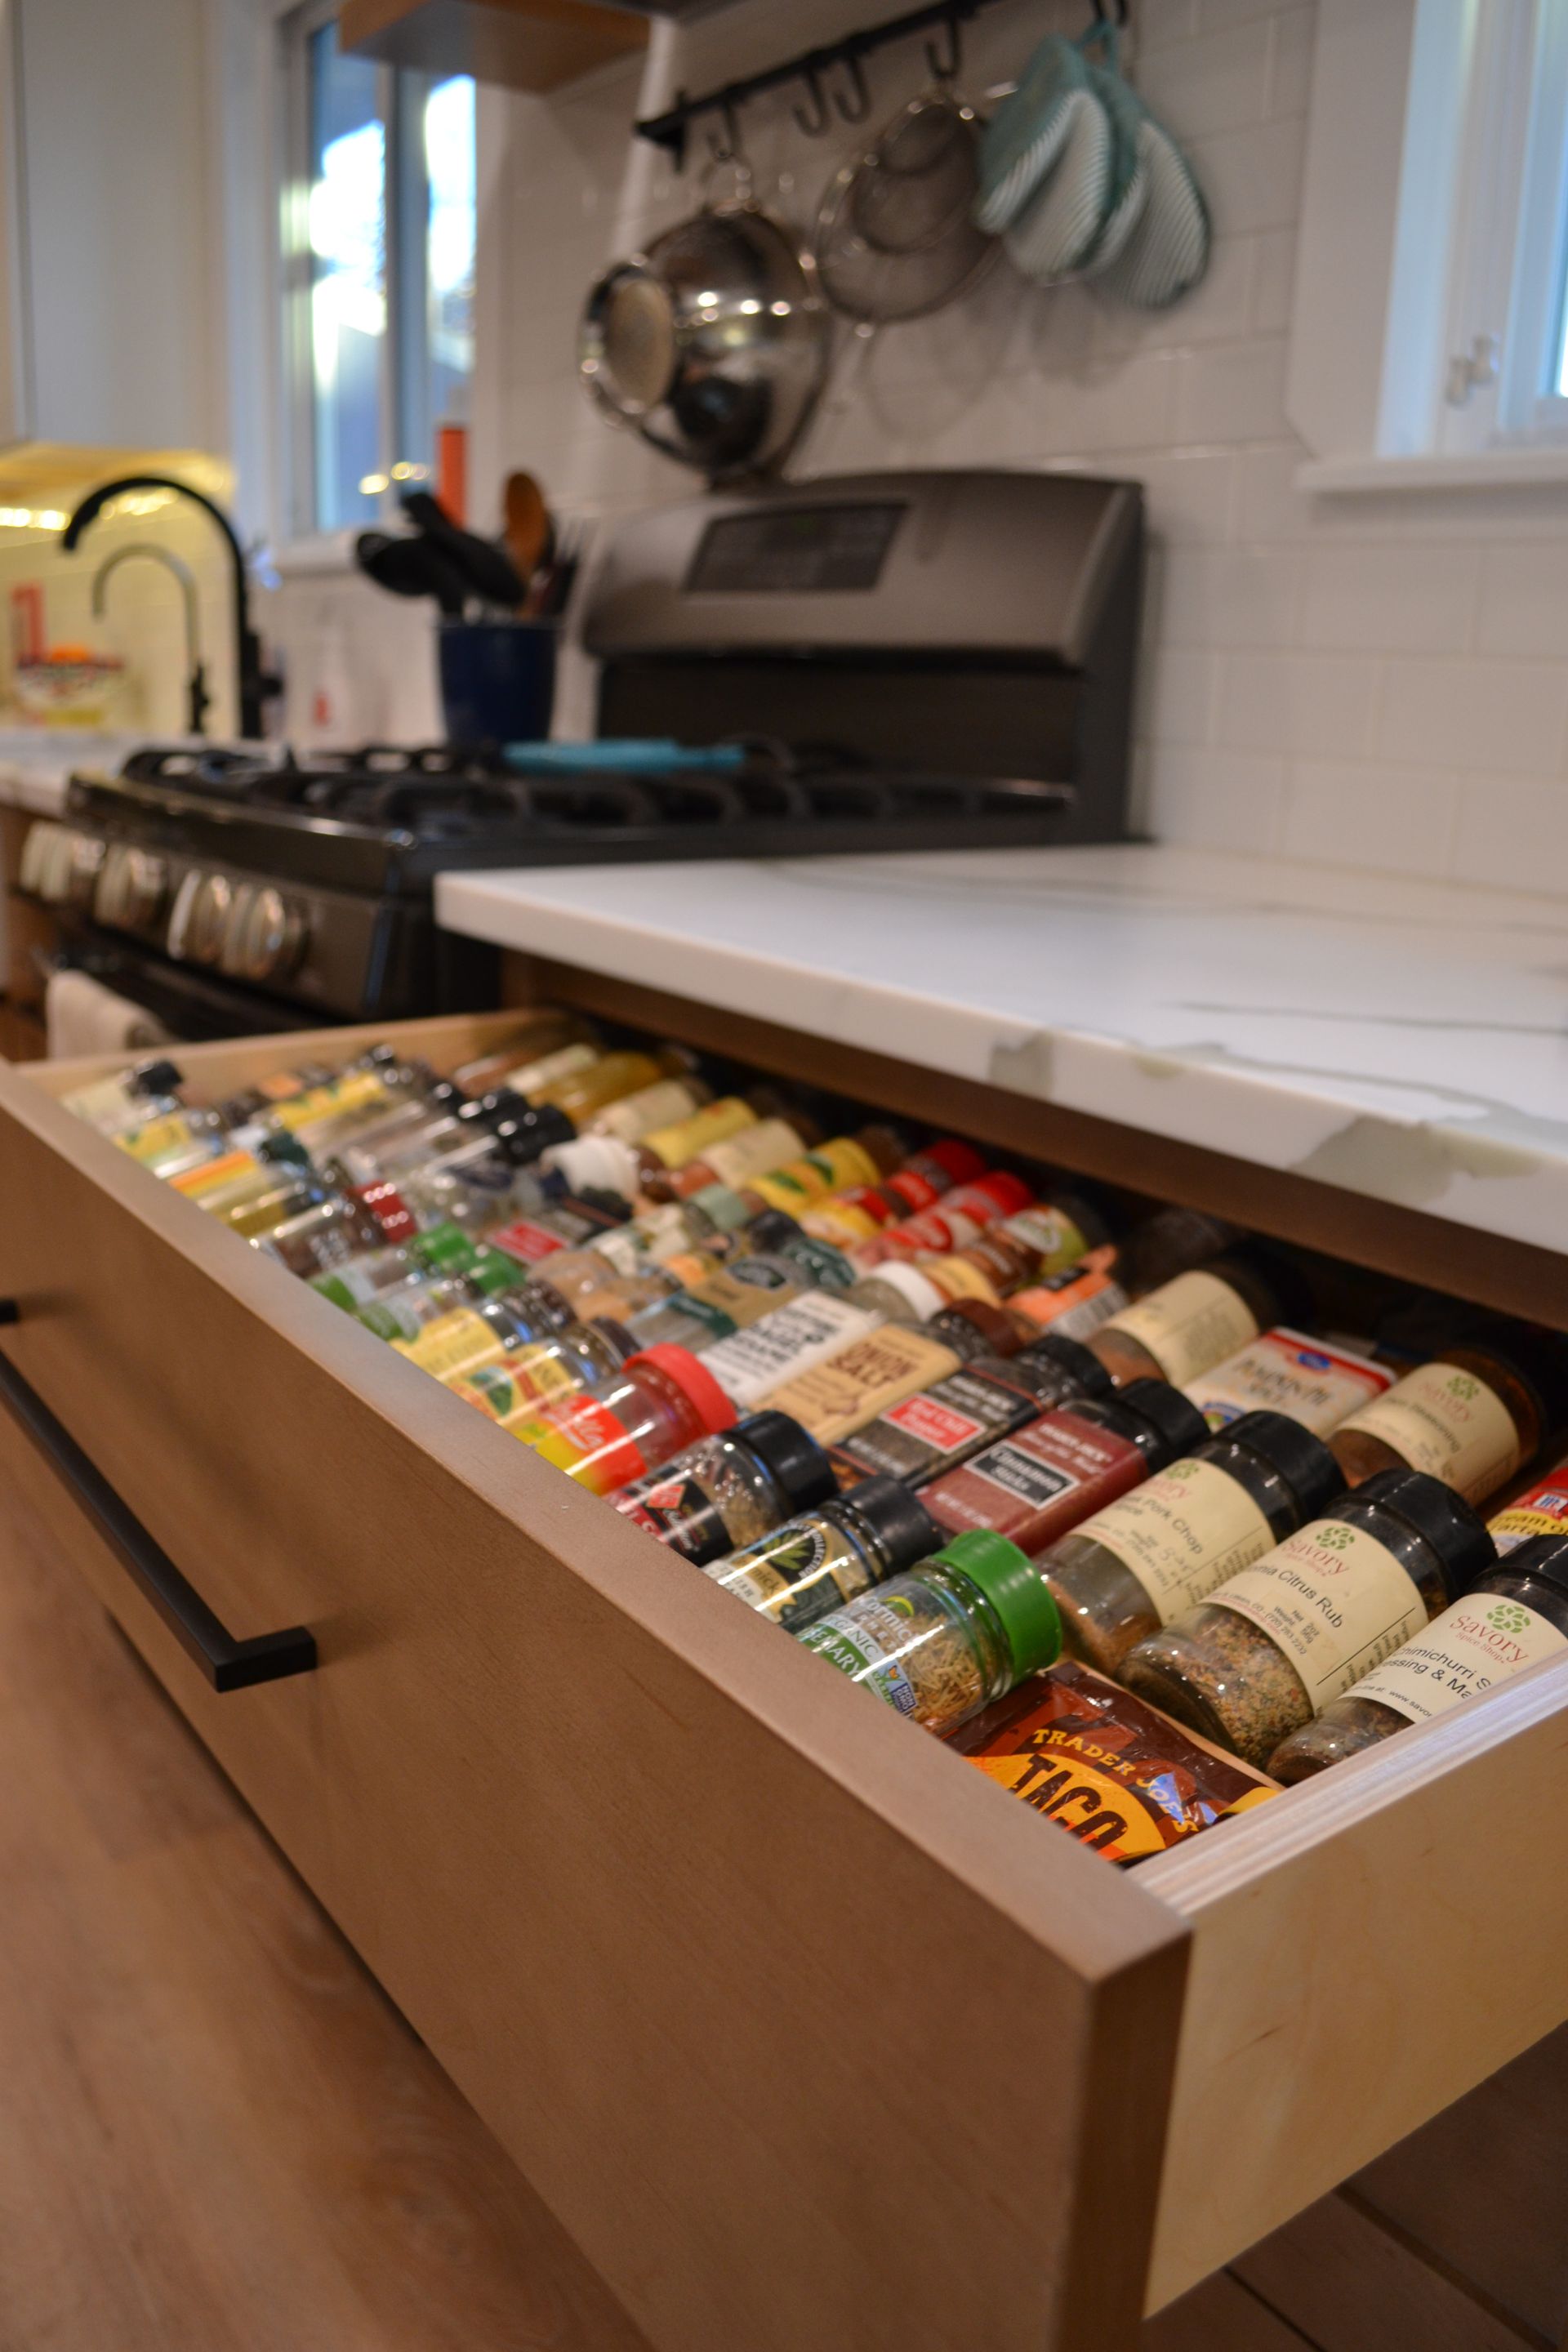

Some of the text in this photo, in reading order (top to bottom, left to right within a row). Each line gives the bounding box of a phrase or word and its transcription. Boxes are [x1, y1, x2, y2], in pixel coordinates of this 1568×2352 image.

[990, 1444, 1062, 1492] Cinnamon
[1143, 1498, 1203, 1555] Pork Chop
[1278, 1568, 1318, 1601] Citrus
[1316, 1597, 1343, 1629] Rub
[1450, 1615, 1530, 1663] savory
[1455, 1632, 1481, 1646] Spice
[902, 1684, 915, 1706] NON
[1431, 1669, 1446, 1682] &
[896, 1689, 910, 1711] GMO
[1007, 1753, 1129, 1851] TACO
[1032, 1728, 1199, 1833] TRADER JOE'S
